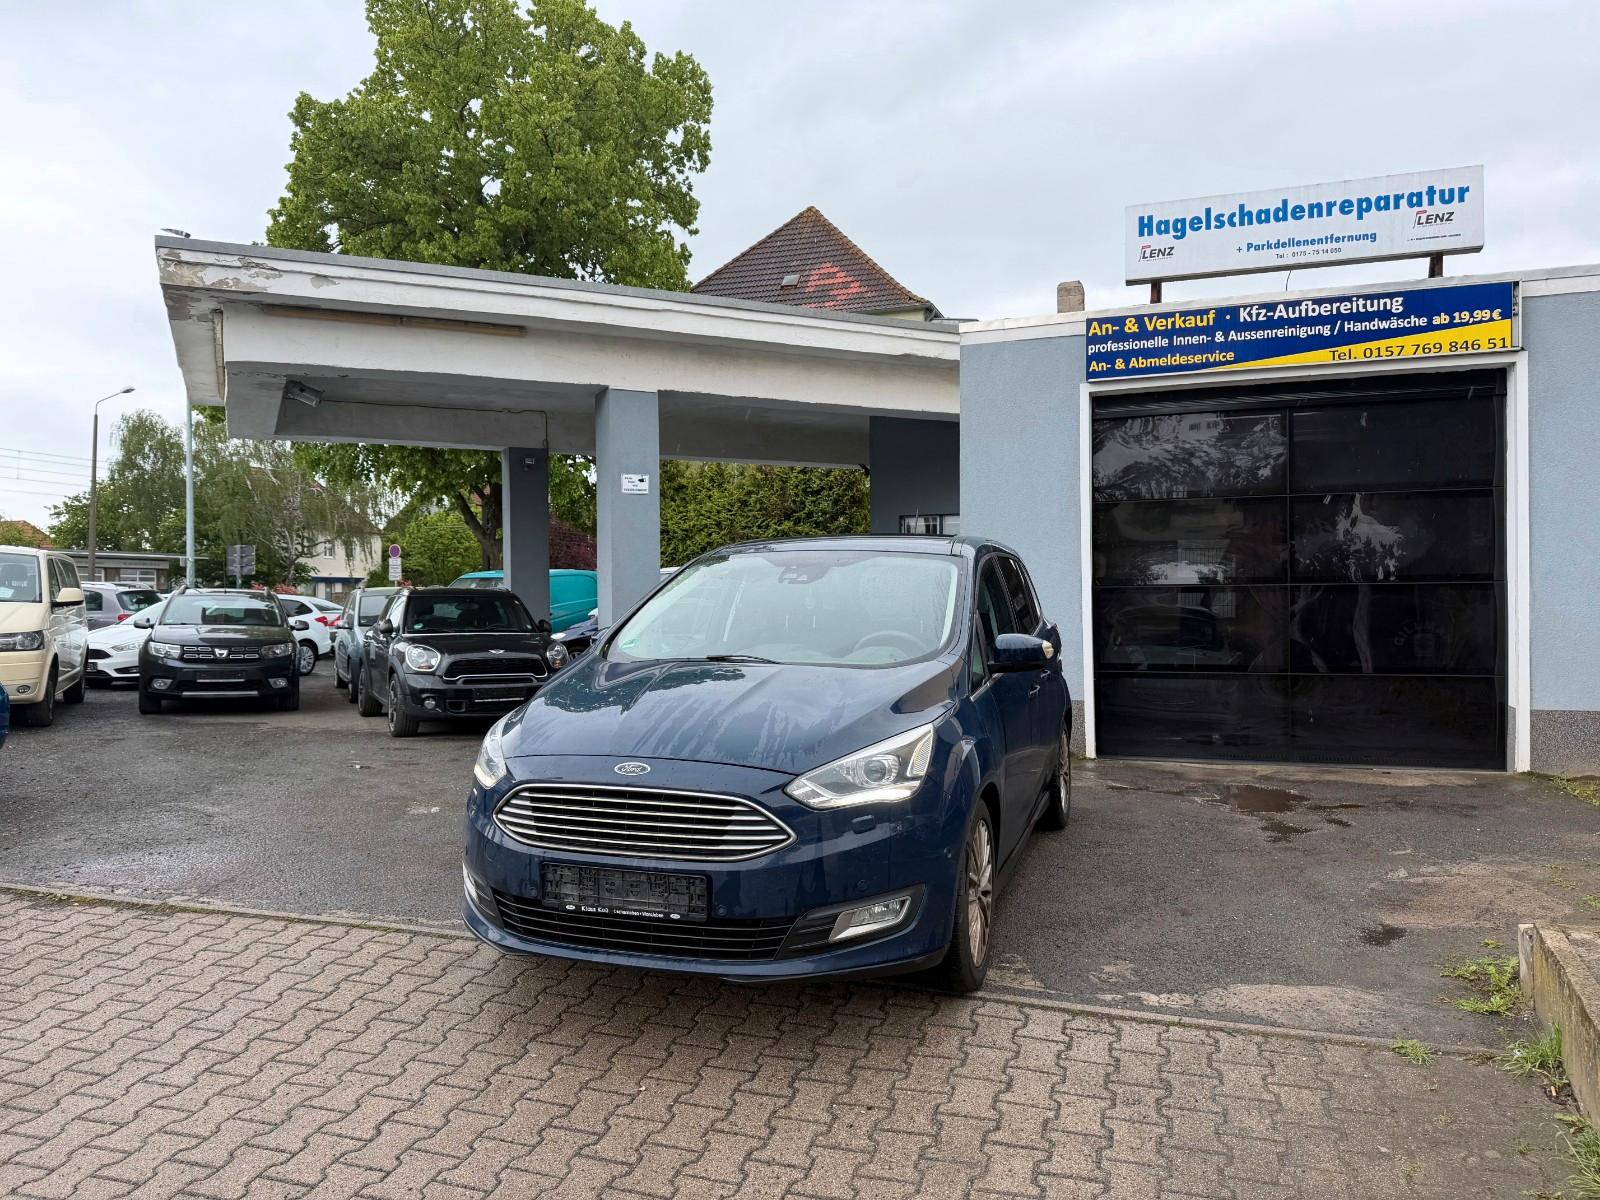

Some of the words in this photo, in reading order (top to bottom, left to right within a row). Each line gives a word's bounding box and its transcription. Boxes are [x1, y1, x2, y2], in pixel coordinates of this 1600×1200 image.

[1138, 185, 1469, 240] Hagelschadenreparatur
[1417, 211, 1455, 226] LENZ
[1142, 246, 1175, 260] LENZ
[1246, 232, 1377, 252] Parkdellenentfernung
[1088, 321, 1119, 337] An-
[1124, 317, 1139, 333] &
[1144, 310, 1216, 332] Verkauf
[1239, 296, 1404, 323] Kfz-Aufbereitung
[1088, 335, 1169, 356] professionelle
[1173, 334, 1211, 347] Innen-
[1214, 331, 1225, 343] &
[1228, 323, 1331, 342] Aussenreinigung
[1344, 313, 1428, 332] Handwäsche
[1432, 313, 1450, 325] ab
[1329, 348, 1357, 361] Tel.
[1363, 345, 1405, 359] 0157
[1412, 342, 1443, 356] 769
[1448, 339, 1481, 353] 846
[1487, 337, 1509, 350] 51
[1089, 360, 1112, 372] An-
[1115, 358, 1125, 370] &
[1129, 350, 1235, 369] Abmeldeservice
